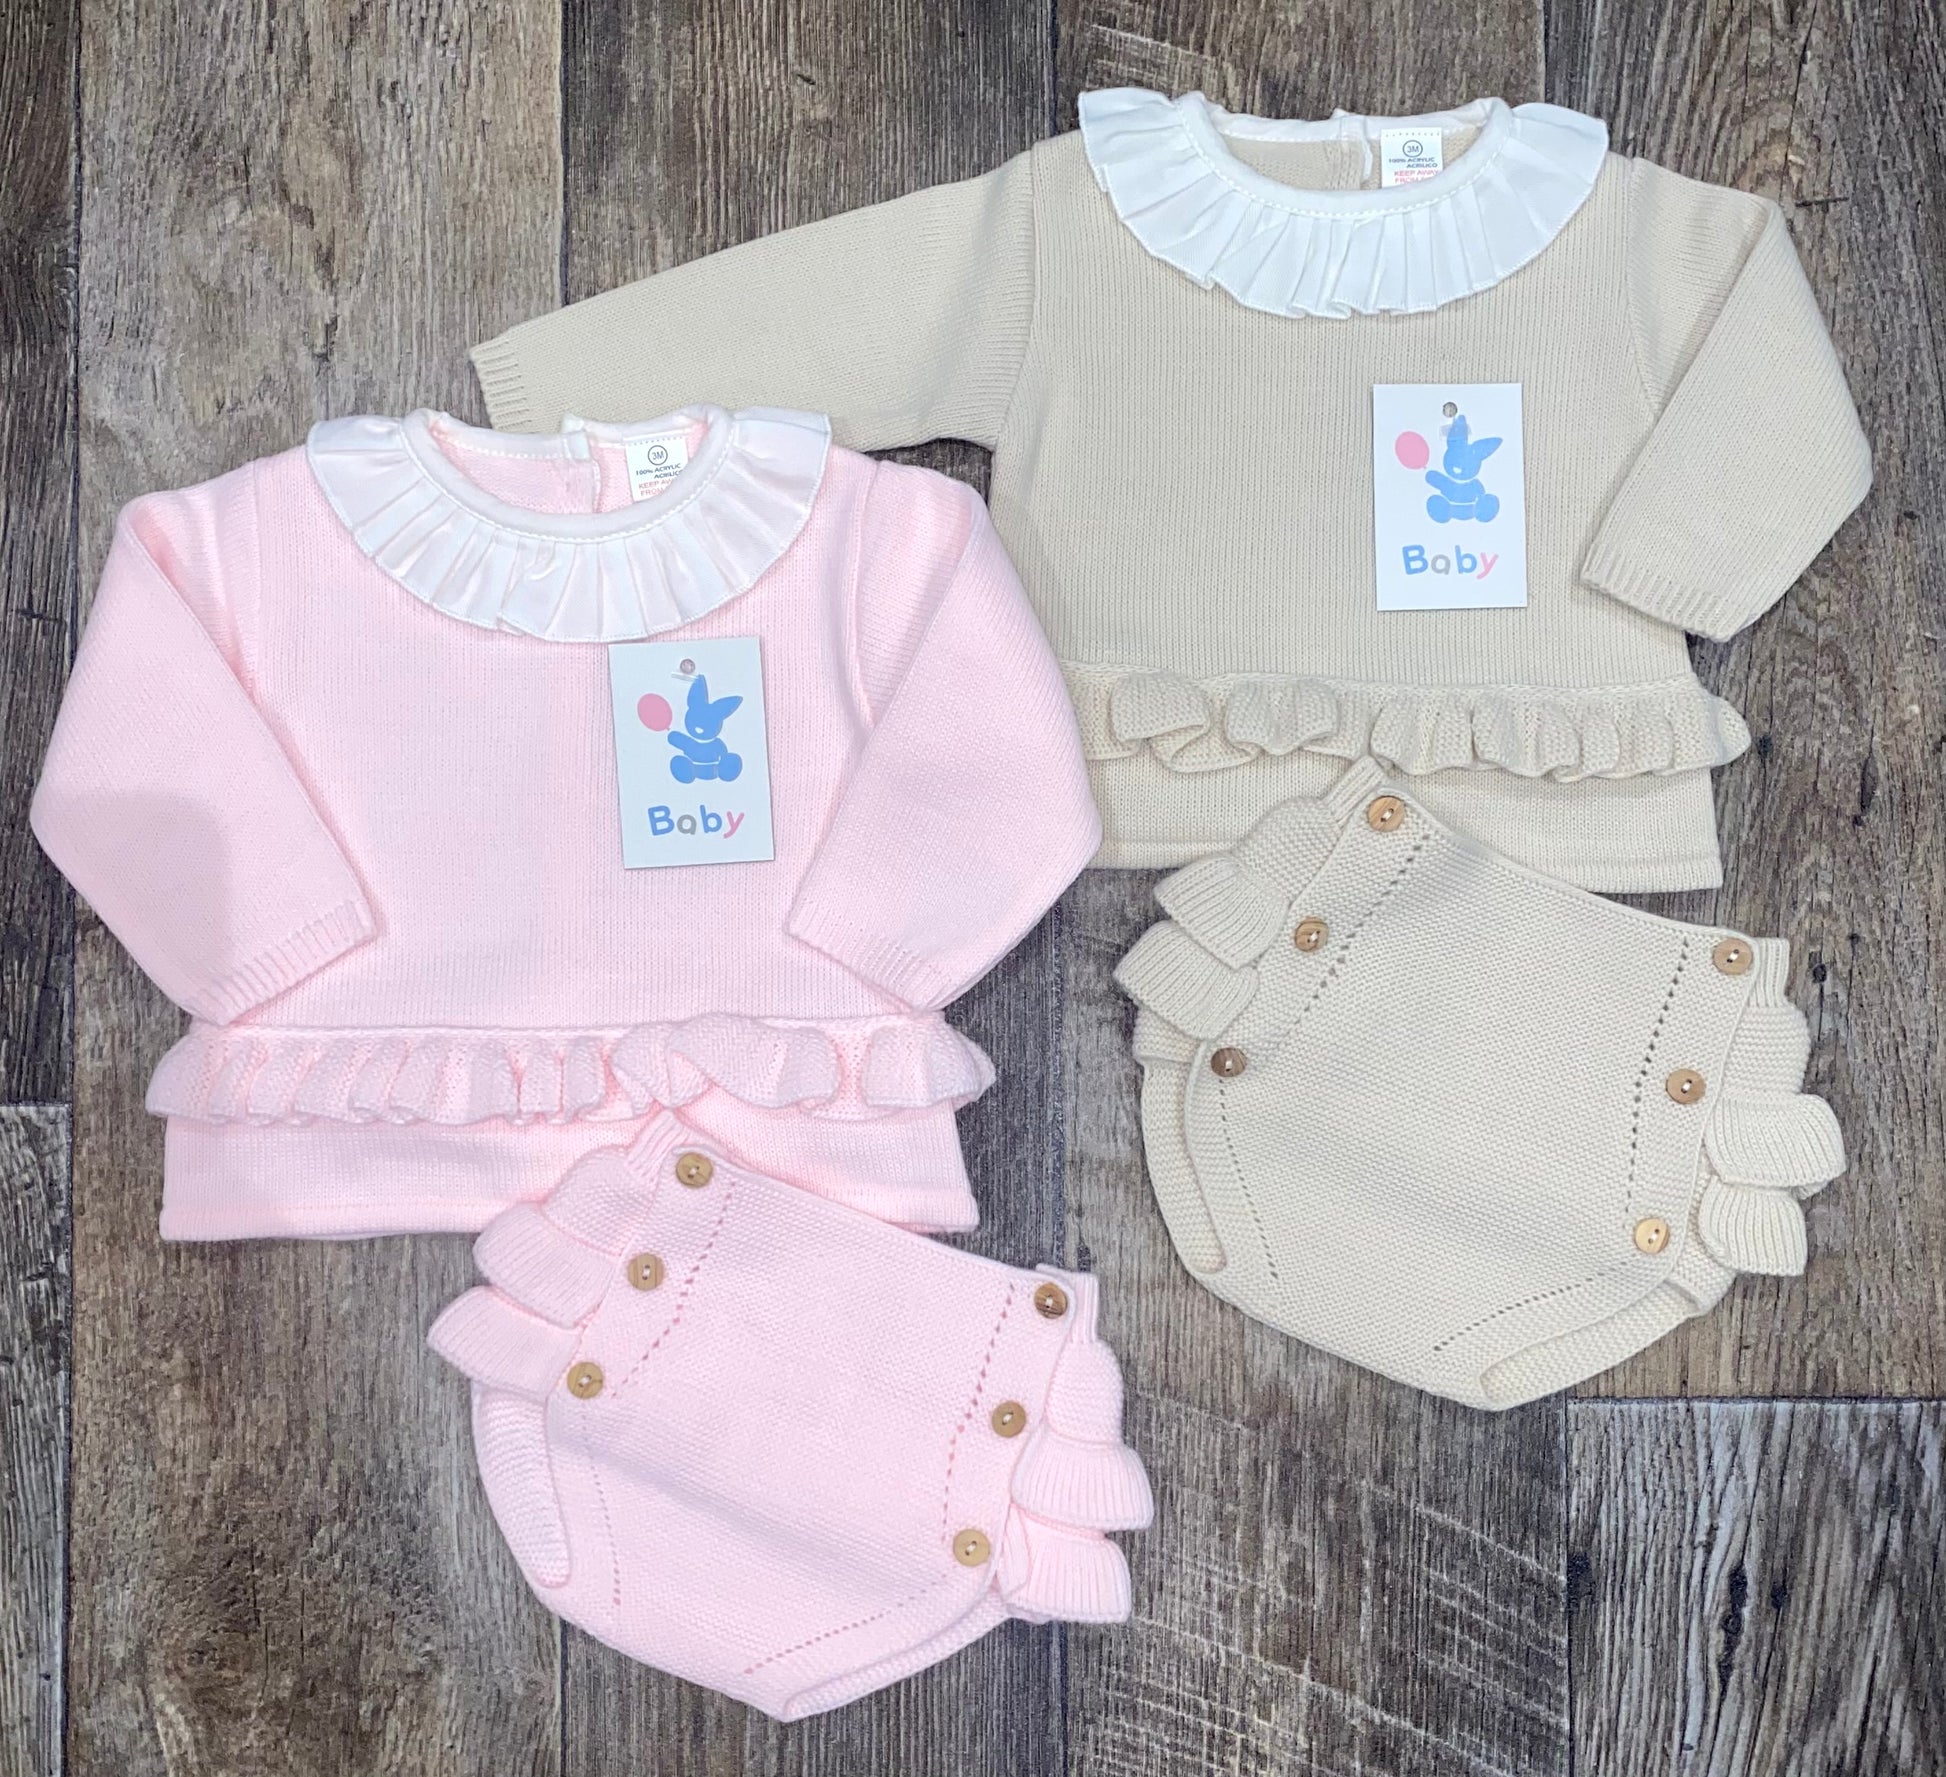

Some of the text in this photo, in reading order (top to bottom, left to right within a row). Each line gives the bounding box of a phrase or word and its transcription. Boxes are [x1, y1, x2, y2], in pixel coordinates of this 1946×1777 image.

[1407, 145, 1419, 153] 3M
[652, 450, 664, 460] 3M
[654, 463, 681, 473] ACRYLIC
[639, 480, 659, 489] KEEP
[1402, 544, 1499, 580] Baby
[648, 804, 745, 839] Baby
